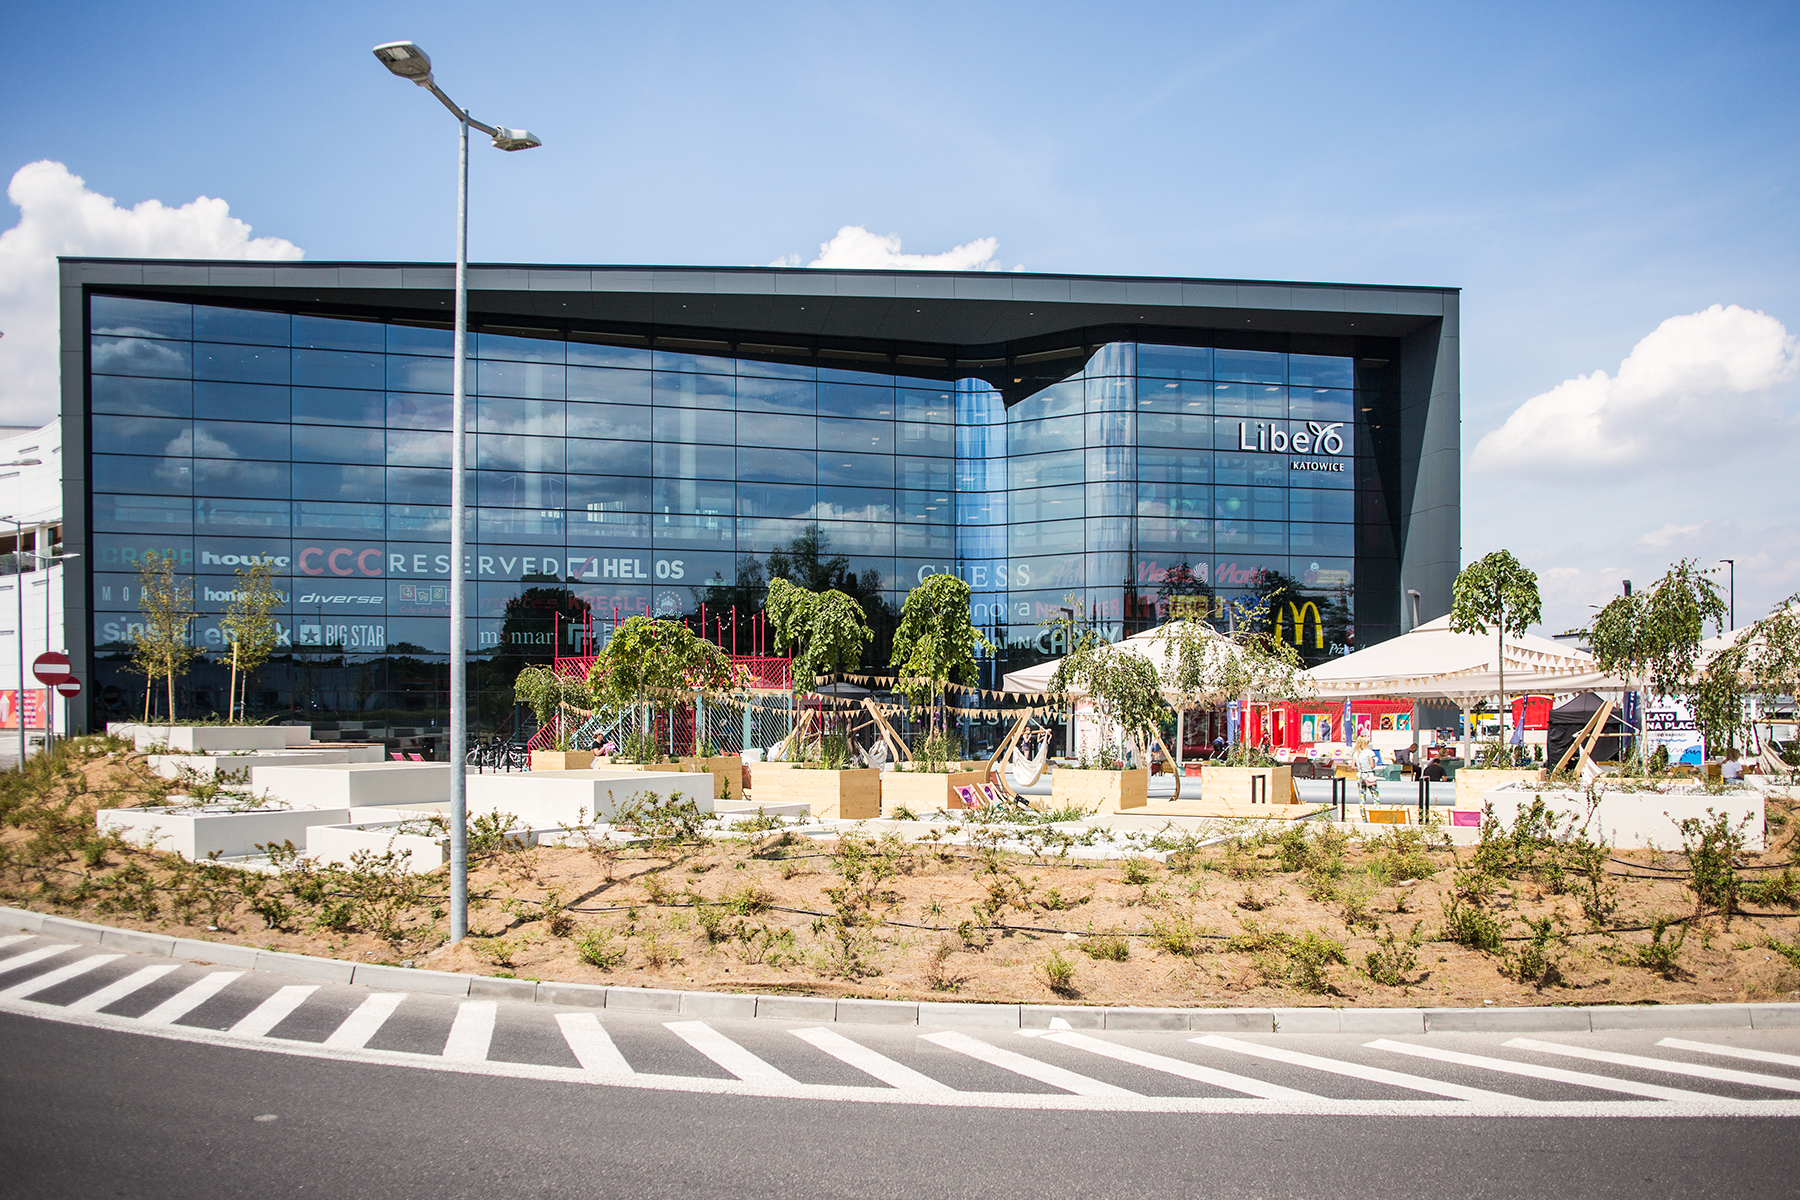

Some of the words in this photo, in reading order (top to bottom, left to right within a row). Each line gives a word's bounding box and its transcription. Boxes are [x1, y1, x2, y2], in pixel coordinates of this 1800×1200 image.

[1240, 422, 1344, 454] Libero
[1293, 461, 1344, 472] KATOWICE
[298, 547, 383, 576] CCC
[1129, 561, 1194, 584] Media
[1214, 563, 1269, 585] Markt
[299, 593, 384, 604] diverse
[326, 625, 347, 646] BIG
[351, 625, 385, 647] STAR
[1646, 713, 1675, 721] LATO
[1647, 722, 1663, 730] NA
